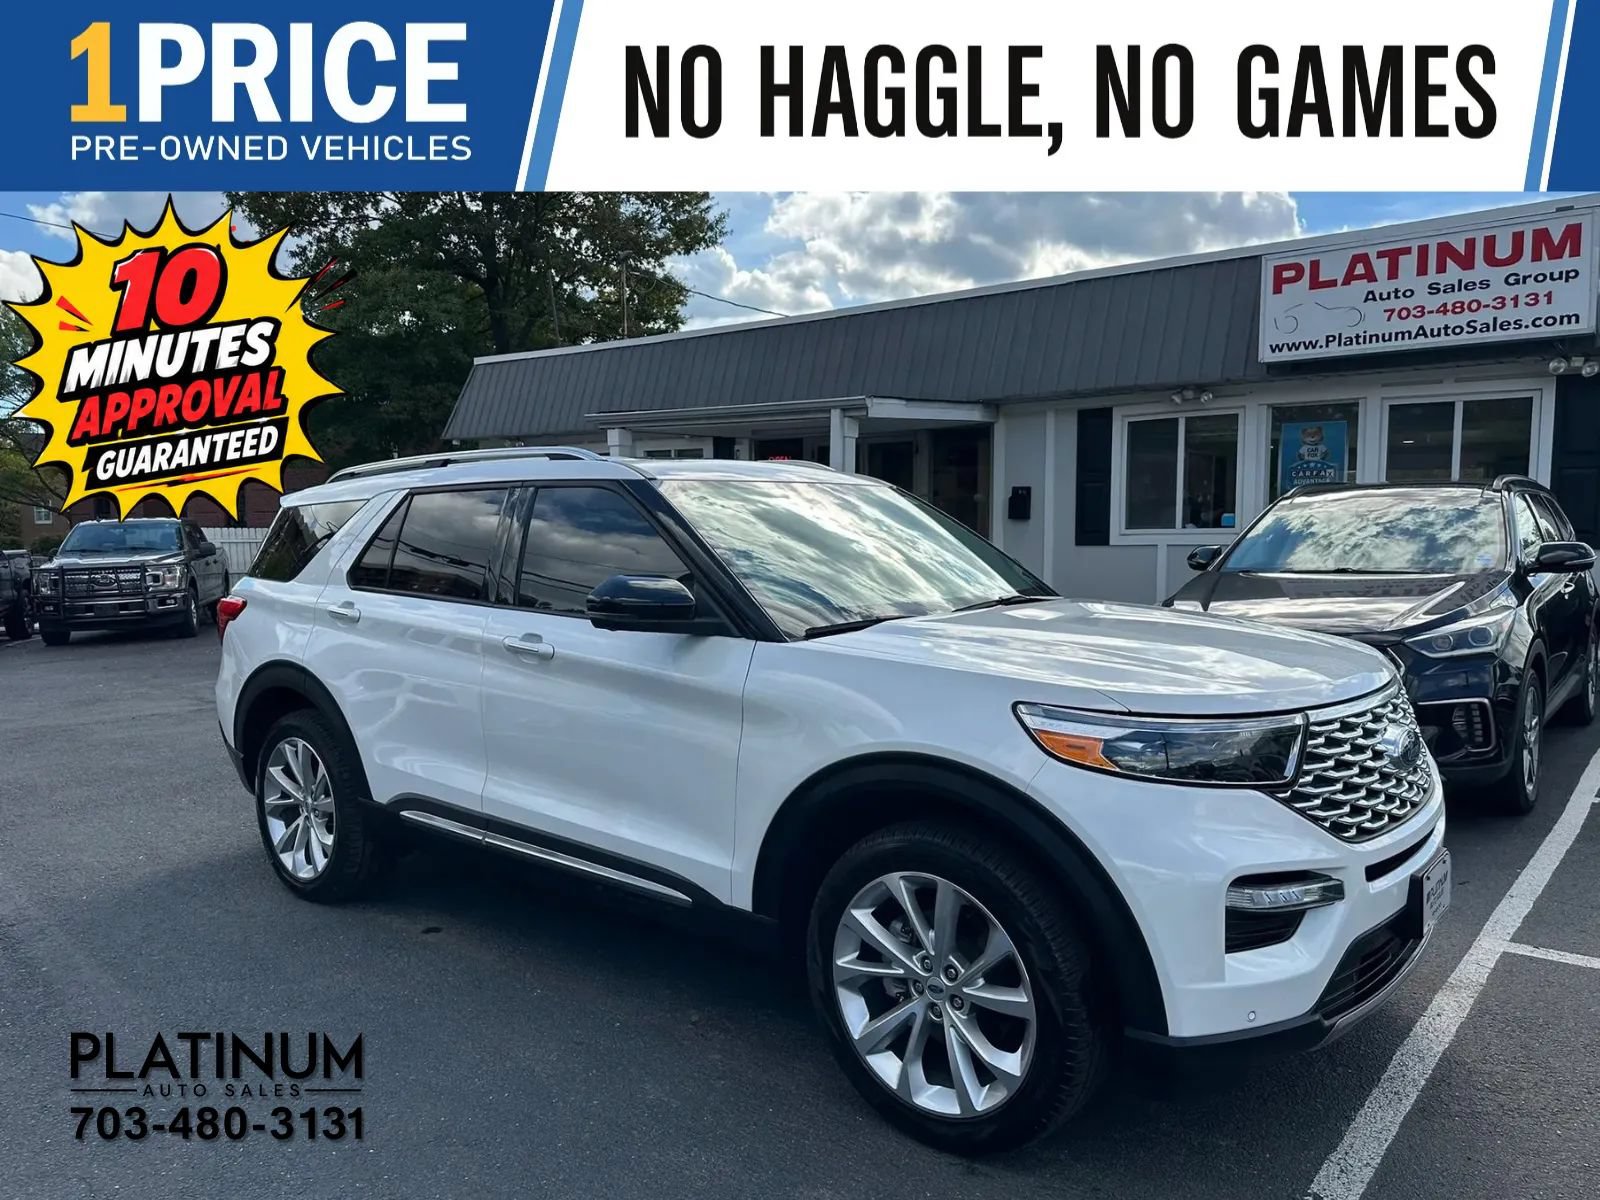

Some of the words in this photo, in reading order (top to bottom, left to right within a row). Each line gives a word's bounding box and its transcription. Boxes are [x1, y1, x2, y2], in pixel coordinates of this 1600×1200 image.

[1272, 222, 1582, 295] PLATINUM
[1363, 287, 1415, 303] Auto
[1427, 277, 1491, 296] Sales
[1504, 267, 1580, 287] Group
[1383, 290, 1554, 322] 703-480-3131
[1269, 312, 1580, 354] www.PlatinumAutoSales.com
